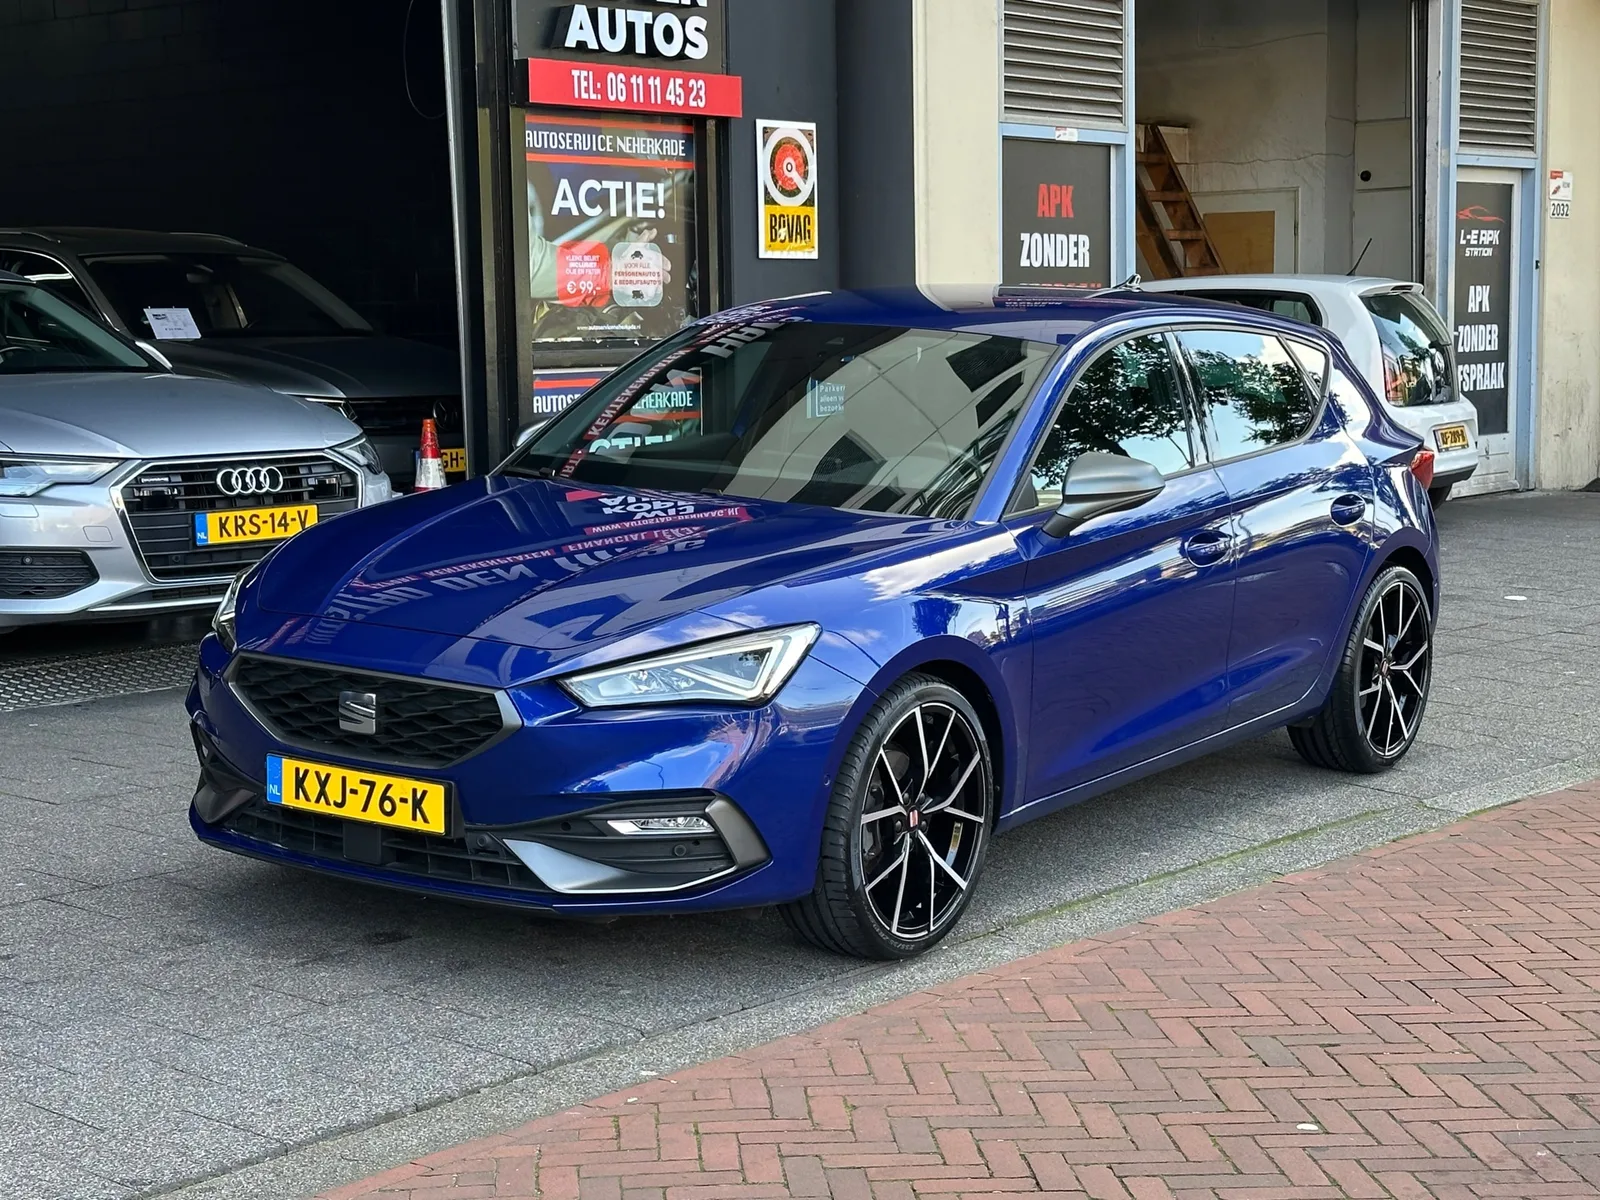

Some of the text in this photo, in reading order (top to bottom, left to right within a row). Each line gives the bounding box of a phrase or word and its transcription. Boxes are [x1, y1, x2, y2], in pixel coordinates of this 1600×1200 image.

[564, 4, 708, 60] AUTOS
[571, 69, 706, 108] TEL: 06 11 11 45 23
[525, 130, 686, 156] AUTOSERVICE NEHERKADE
[551, 178, 666, 219] ACTIE!
[1037, 183, 1074, 218] APK
[1551, 202, 1570, 217] 2032
[769, 213, 811, 243] BOVAG
[1479, 229, 1500, 245] APK
[1019, 232, 1090, 268] ZONDER
[1465, 247, 1493, 257] STATION
[566, 280, 601, 295] € 99,-
[1467, 285, 1490, 312] APK
[1457, 323, 1499, 353] ZONDER
[1458, 362, 1505, 392] FSPRAAK
[632, 390, 694, 409] HERKADE
[219, 509, 308, 538] KRS-14-V
[269, 784, 281, 796] NL
[294, 766, 430, 825] KXJ-76-K
